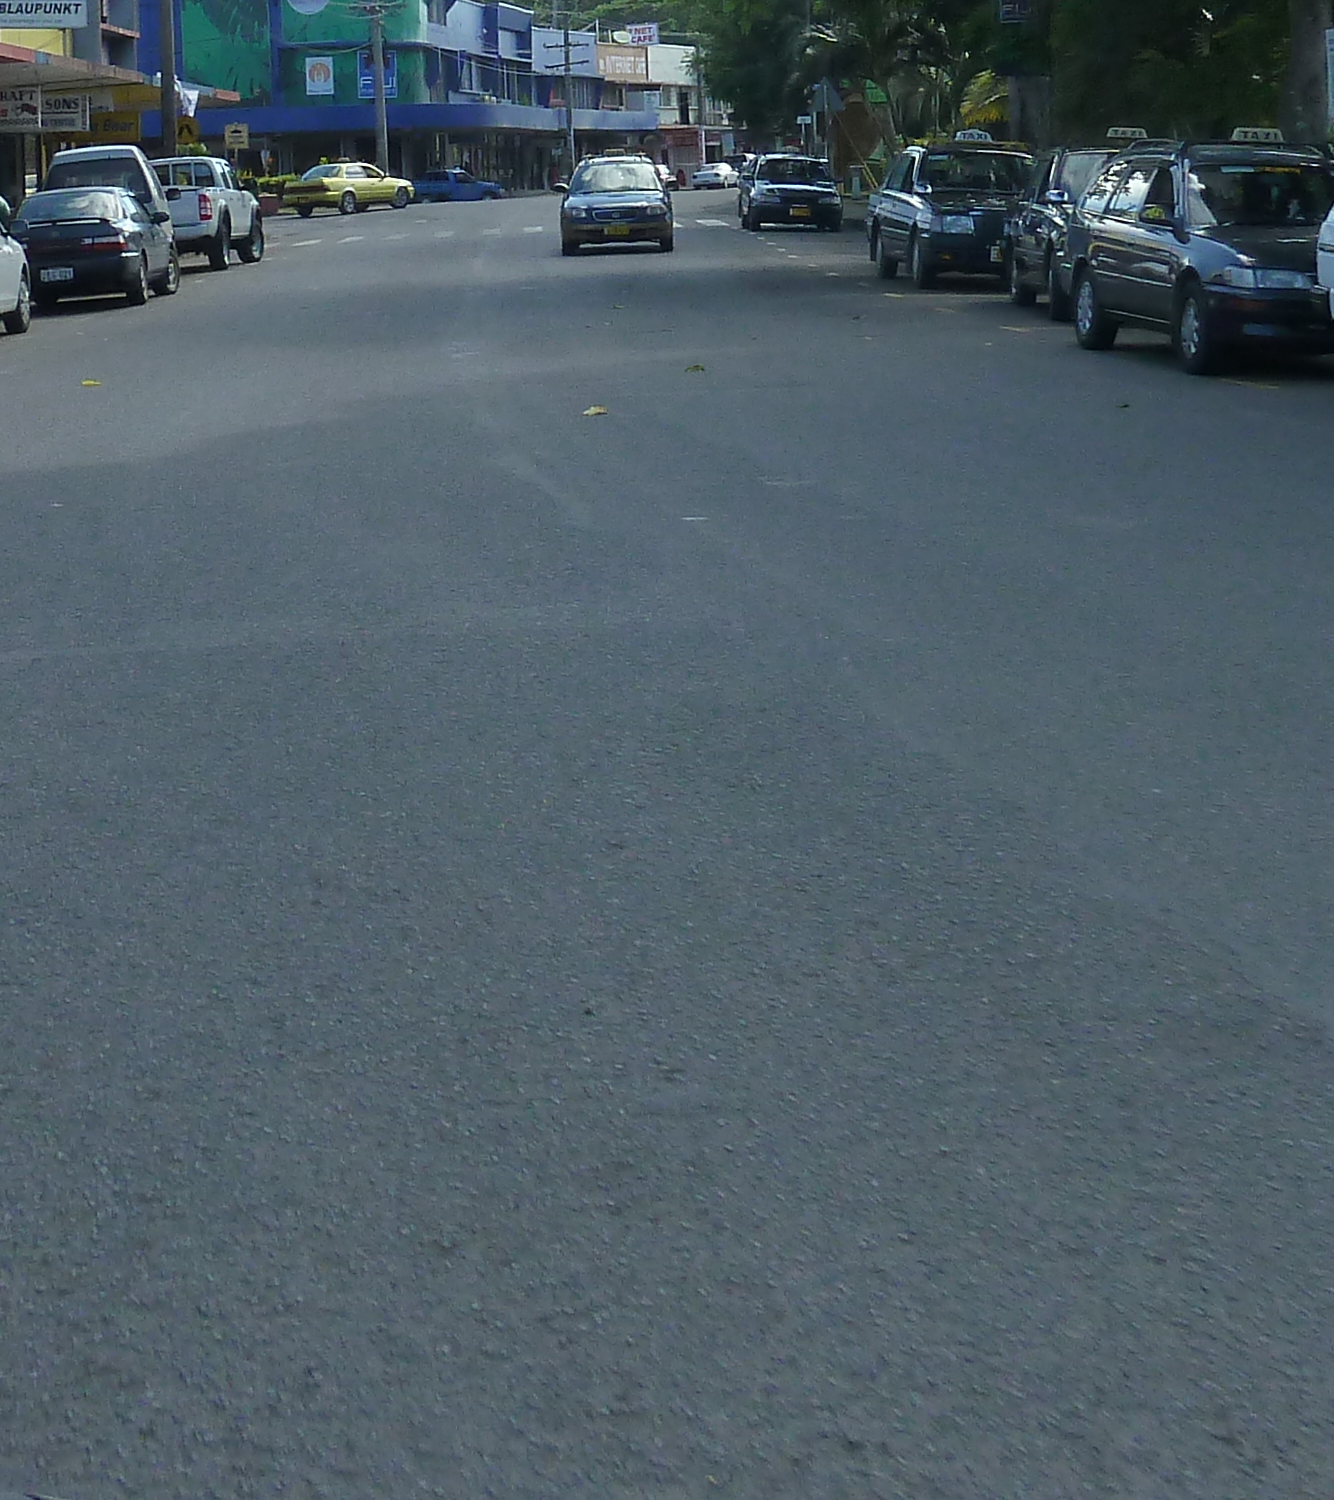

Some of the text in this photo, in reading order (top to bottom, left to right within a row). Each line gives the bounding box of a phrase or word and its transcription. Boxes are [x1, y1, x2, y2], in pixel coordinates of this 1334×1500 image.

[361, 76, 396, 89] FJI
[47, 97, 80, 110] SONS
[1113, 129, 1143, 137] TAXI
[1240, 131, 1278, 140] TAXI
